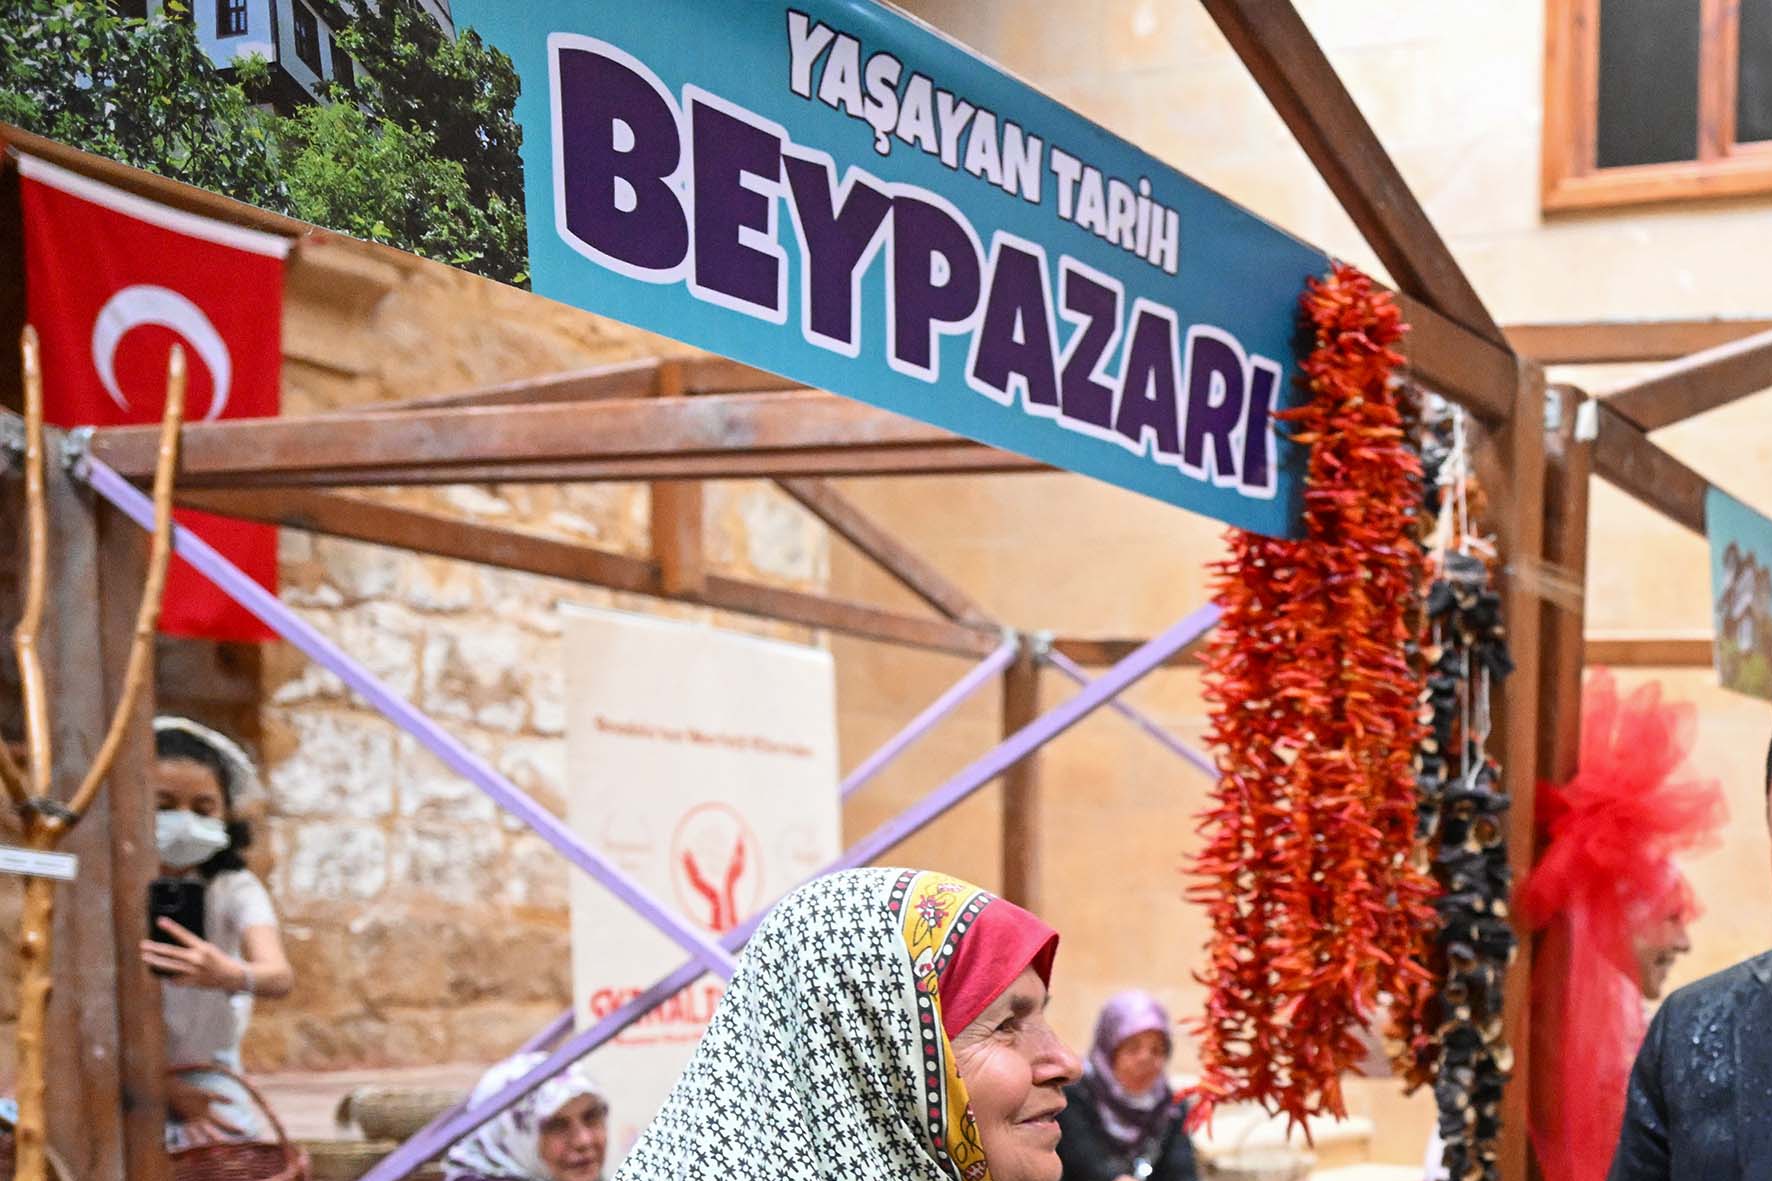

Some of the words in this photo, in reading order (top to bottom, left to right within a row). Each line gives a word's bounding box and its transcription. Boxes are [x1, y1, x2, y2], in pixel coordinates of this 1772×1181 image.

[547, 32, 1283, 500] BEYPAZARI
[787, 9, 1043, 204] YAŞAYAN
[1050, 144, 1180, 275] TARİH
